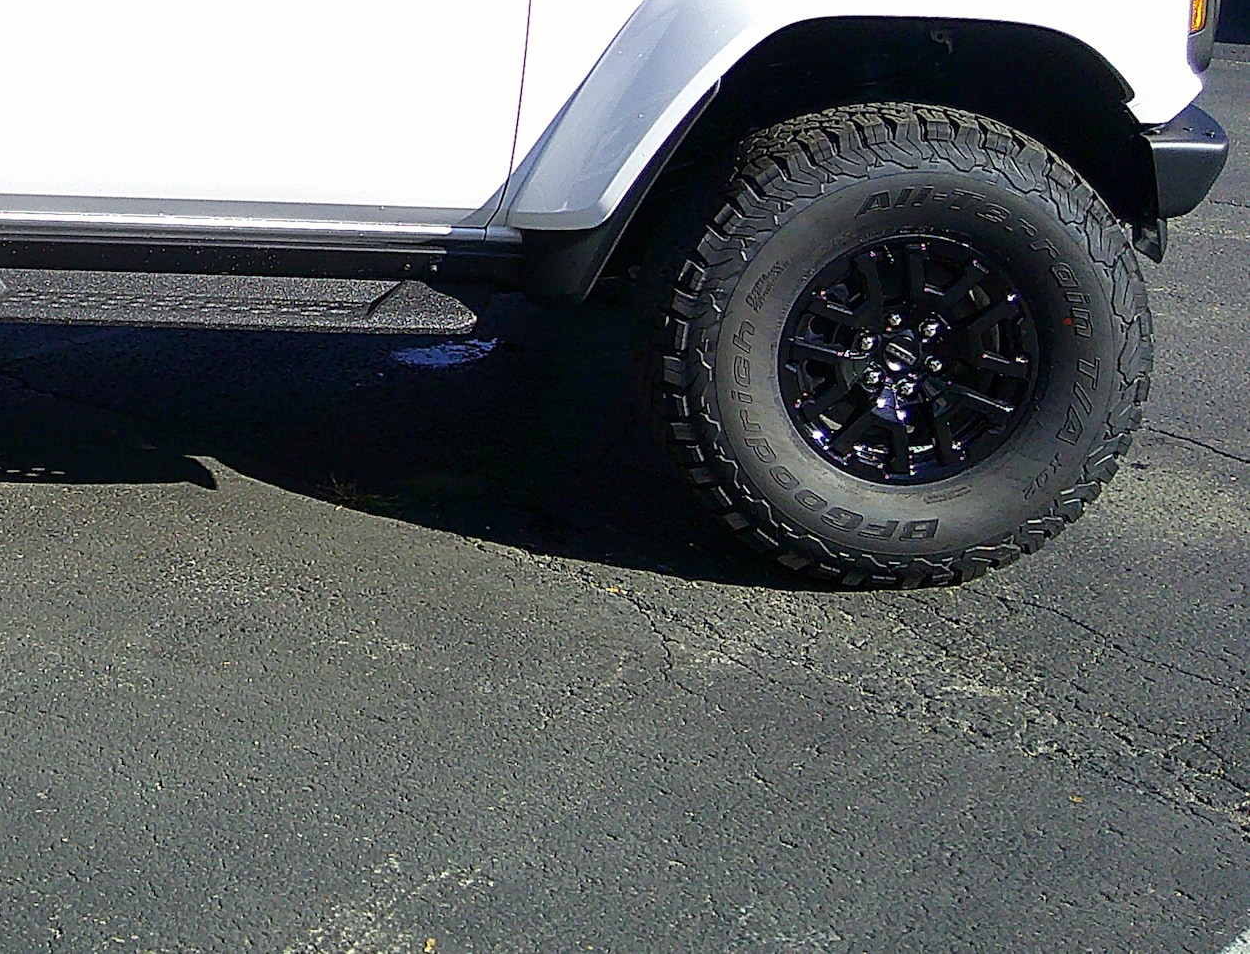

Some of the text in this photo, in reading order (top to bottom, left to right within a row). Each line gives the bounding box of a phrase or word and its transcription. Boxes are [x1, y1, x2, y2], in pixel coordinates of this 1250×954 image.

[730, 319, 939, 541] BFGoodrich
[855, 185, 1093, 338] All-Terrain
[1056, 357, 1100, 446] T/A
